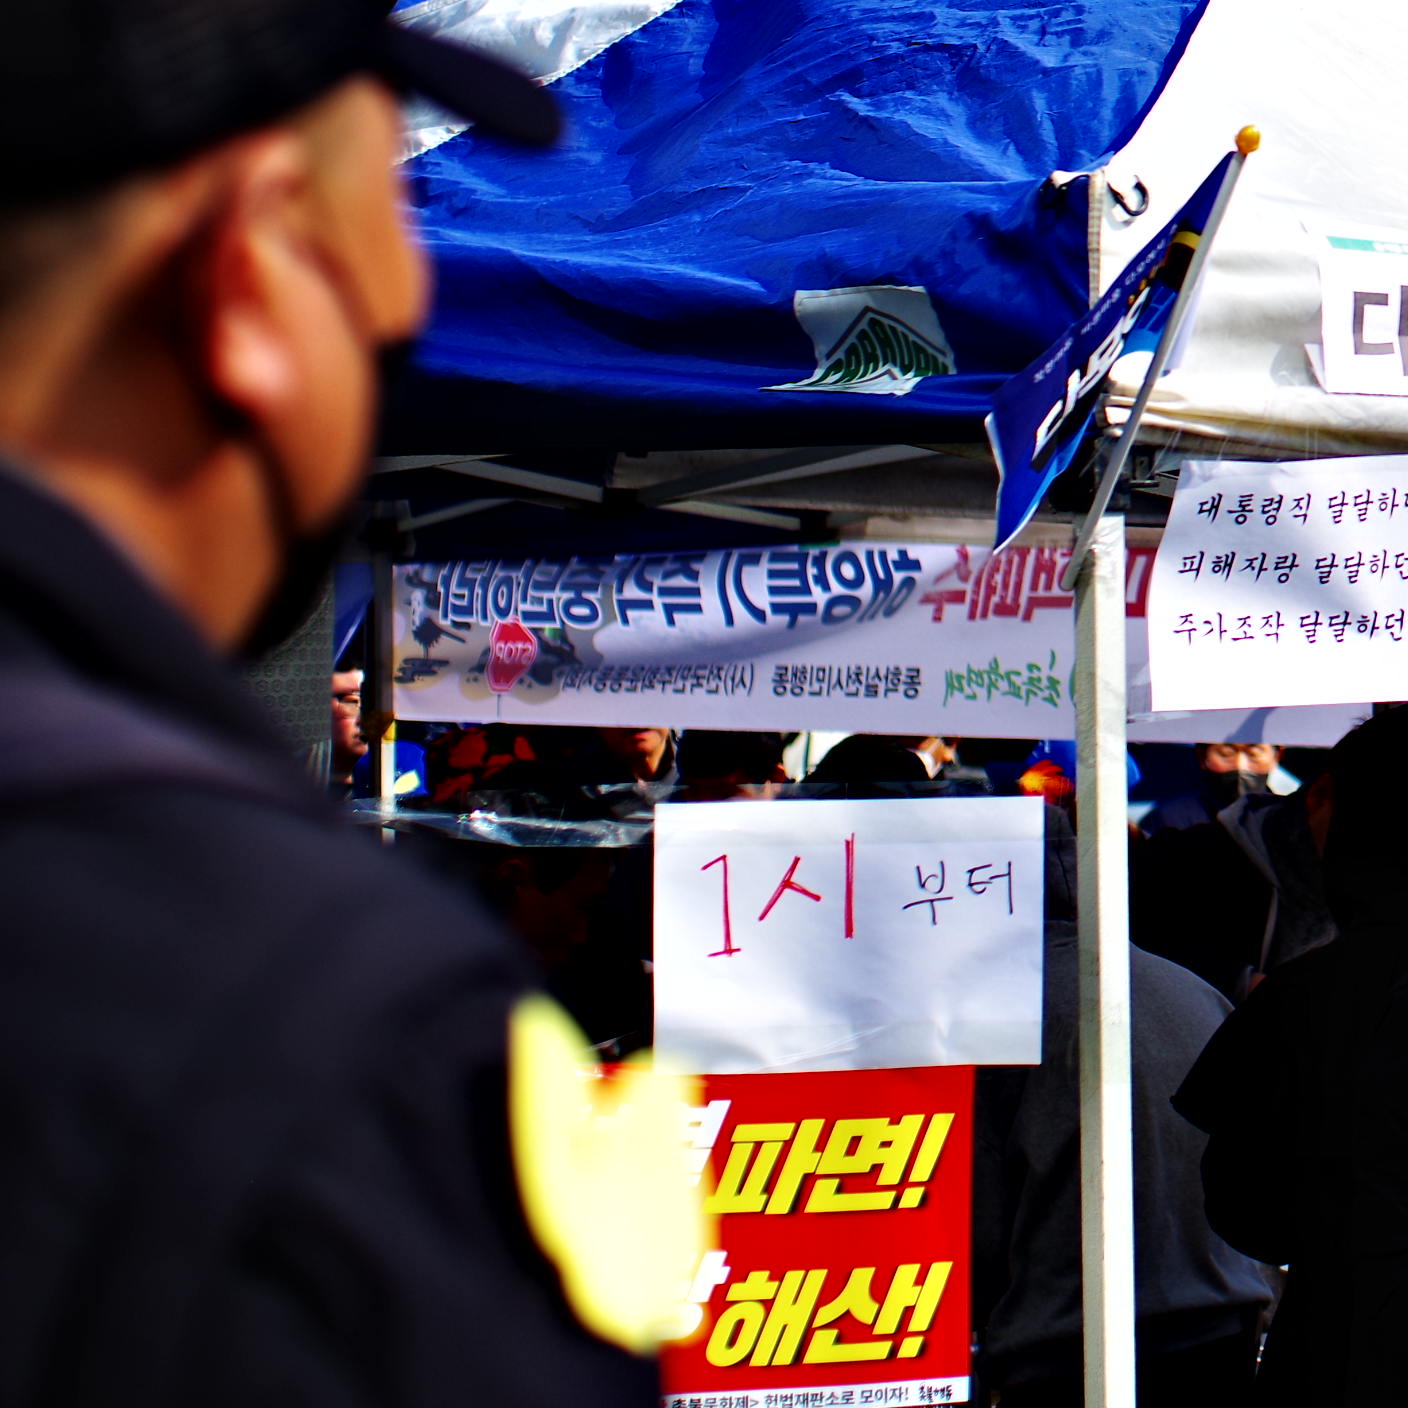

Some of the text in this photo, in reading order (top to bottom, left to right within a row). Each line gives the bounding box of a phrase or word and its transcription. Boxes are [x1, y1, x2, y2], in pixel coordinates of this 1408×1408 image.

[1197, 492, 1312, 525] 대통령직
[1177, 550, 1299, 584] 피해자랑
[1172, 610, 1285, 645] 주가조작
[701, 832, 1015, 957] 1시 부터
[701, 1112, 956, 1216] 파면!
[704, 1260, 955, 1368] 해산!
[764, 1389, 855, 1408] 헌법재판소로
[860, 1387, 910, 1404] 모이자!
